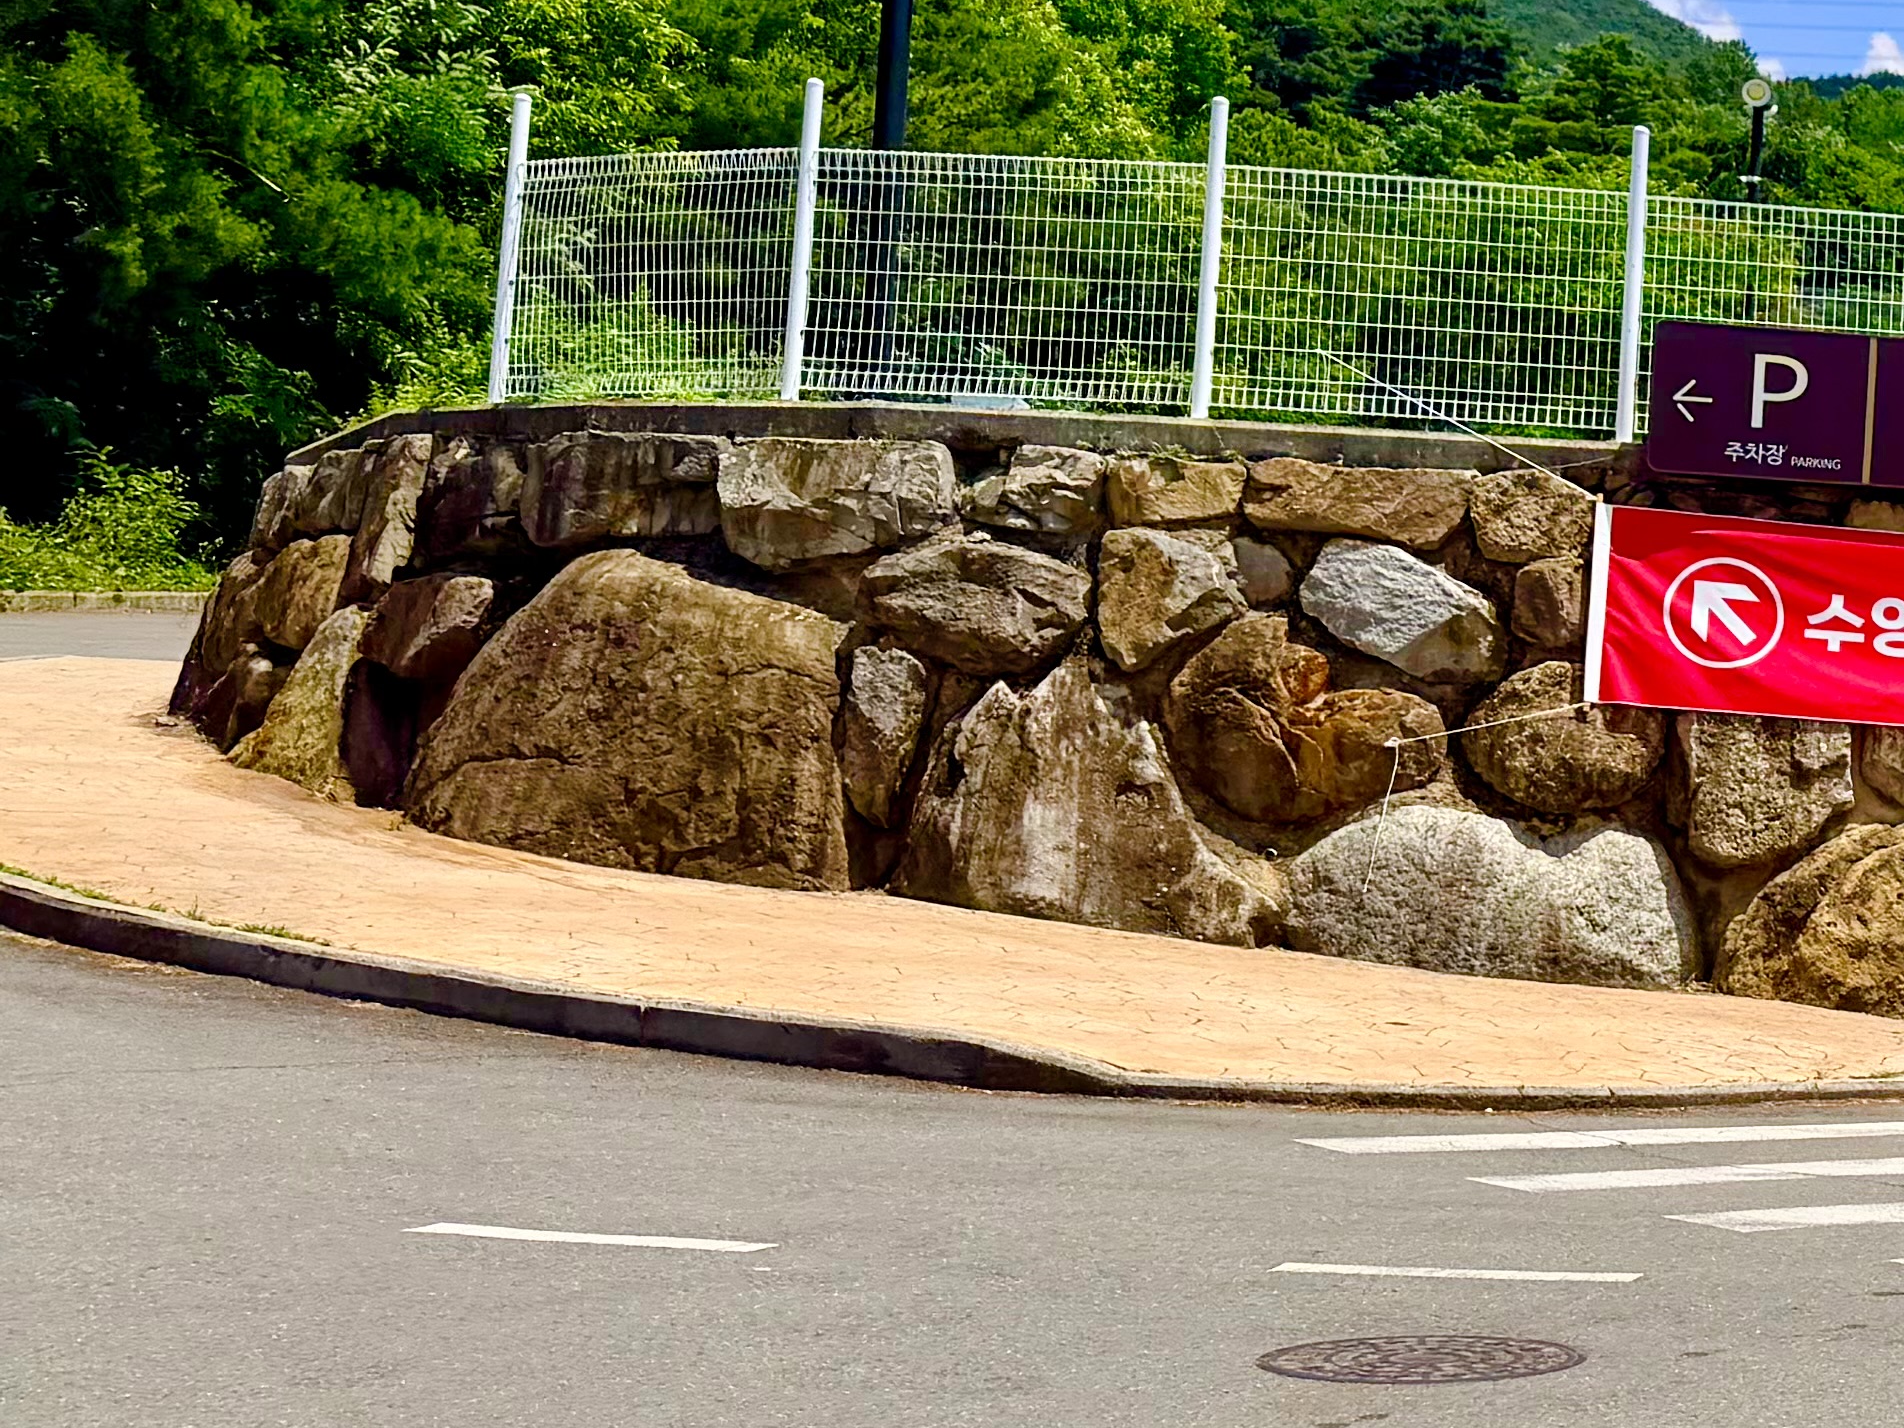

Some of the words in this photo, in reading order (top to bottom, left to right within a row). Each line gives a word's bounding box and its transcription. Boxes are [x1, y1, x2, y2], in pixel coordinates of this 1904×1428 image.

[1751, 353, 1809, 429] P
[1724, 441, 1787, 466] 주차장
[1791, 455, 1841, 470] PARKING
